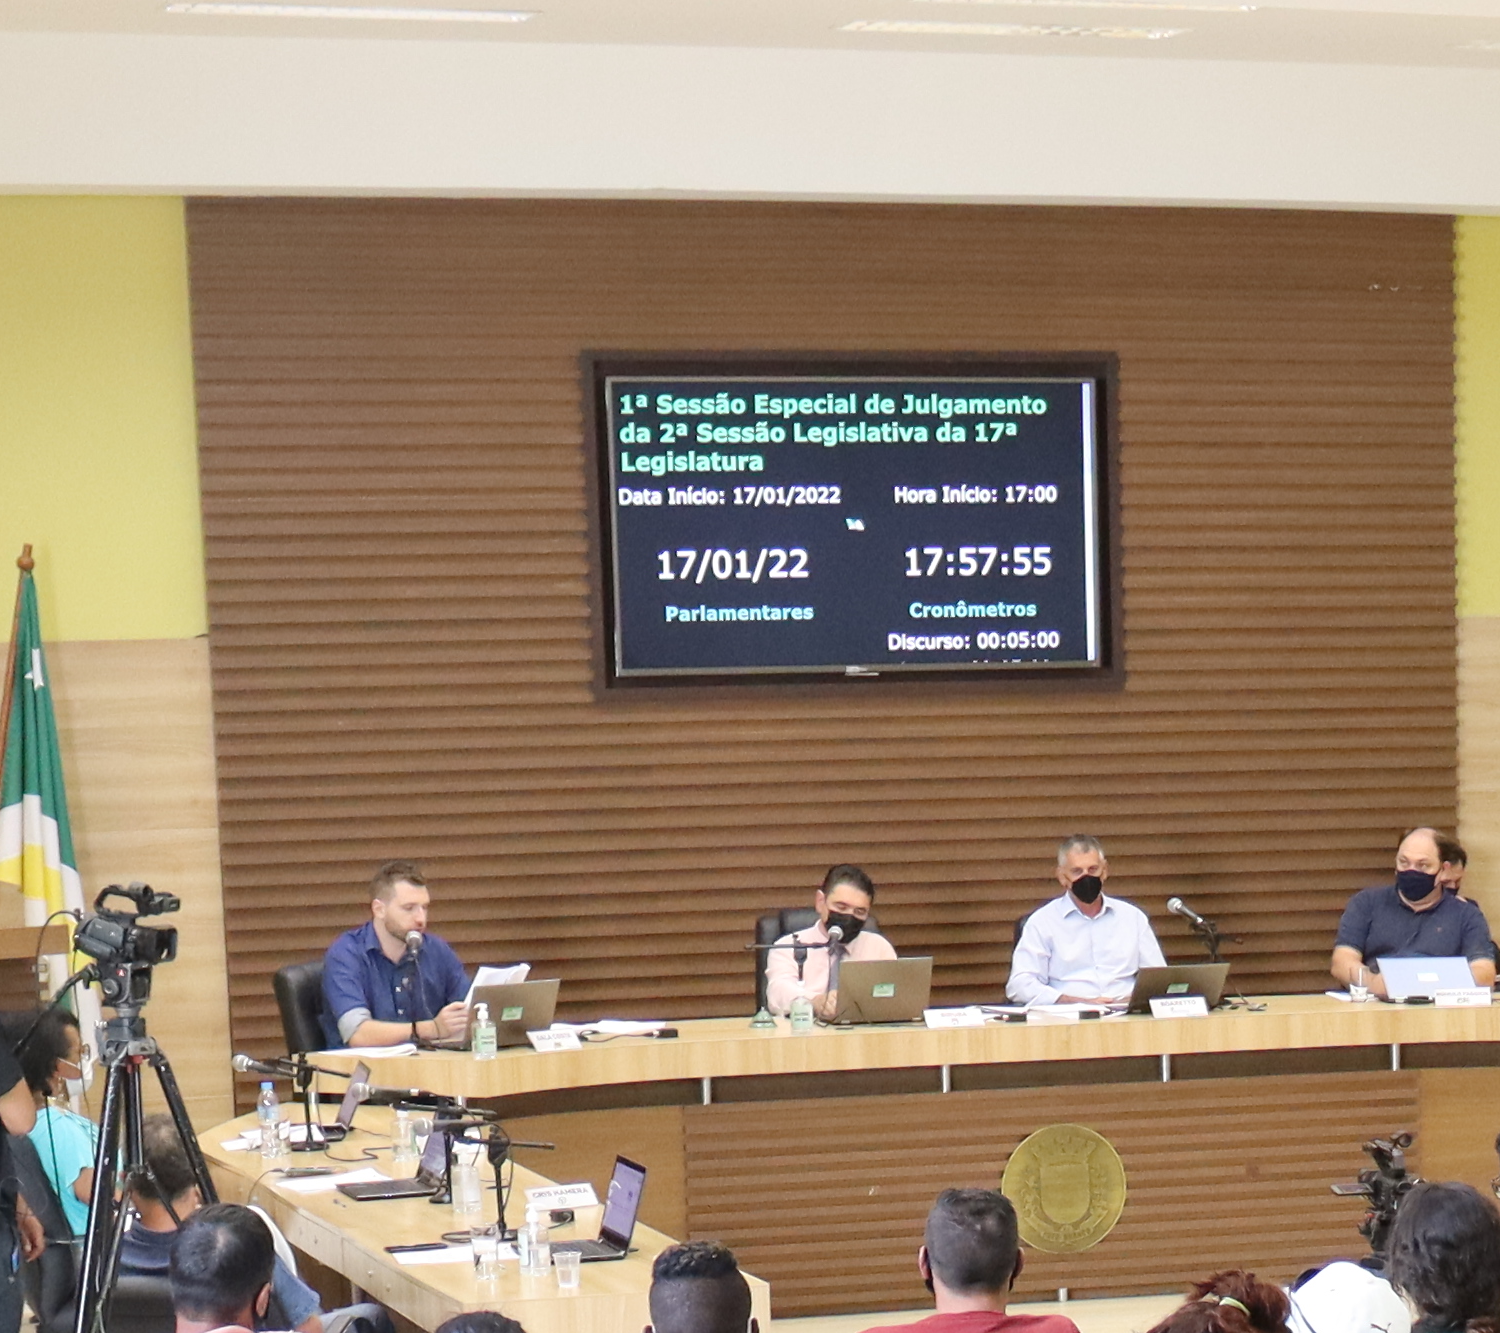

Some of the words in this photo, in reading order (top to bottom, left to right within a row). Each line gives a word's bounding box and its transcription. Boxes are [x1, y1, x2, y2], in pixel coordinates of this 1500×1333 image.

[620, 394, 648, 414] 1ª
[656, 392, 746, 414] Sessão
[754, 393, 856, 418] Especial
[864, 393, 895, 414] de
[901, 393, 1047, 418] Julgamento
[619, 422, 650, 443] da
[659, 423, 688, 443] 2ª
[696, 421, 786, 443] Sessão
[793, 421, 928, 446] Legislativa
[935, 422, 966, 442] da
[975, 422, 1017, 442] 17ª
[621, 451, 764, 476] Legislatura
[618, 488, 662, 505] Data
[667, 485, 725, 505] Início:
[733, 486, 841, 507] 17/01/2022
[894, 486, 936, 503] Hora
[942, 484, 998, 503] Início:
[1005, 485, 1058, 503] 17:00
[657, 548, 810, 584] 17/01/22
[905, 547, 1052, 577] 17:57:55
[665, 605, 814, 622] Parlamentares
[909, 600, 1037, 618] Cronômetros
[888, 633, 971, 651] Discurso:
[977, 631, 1060, 649] 00:05:00
